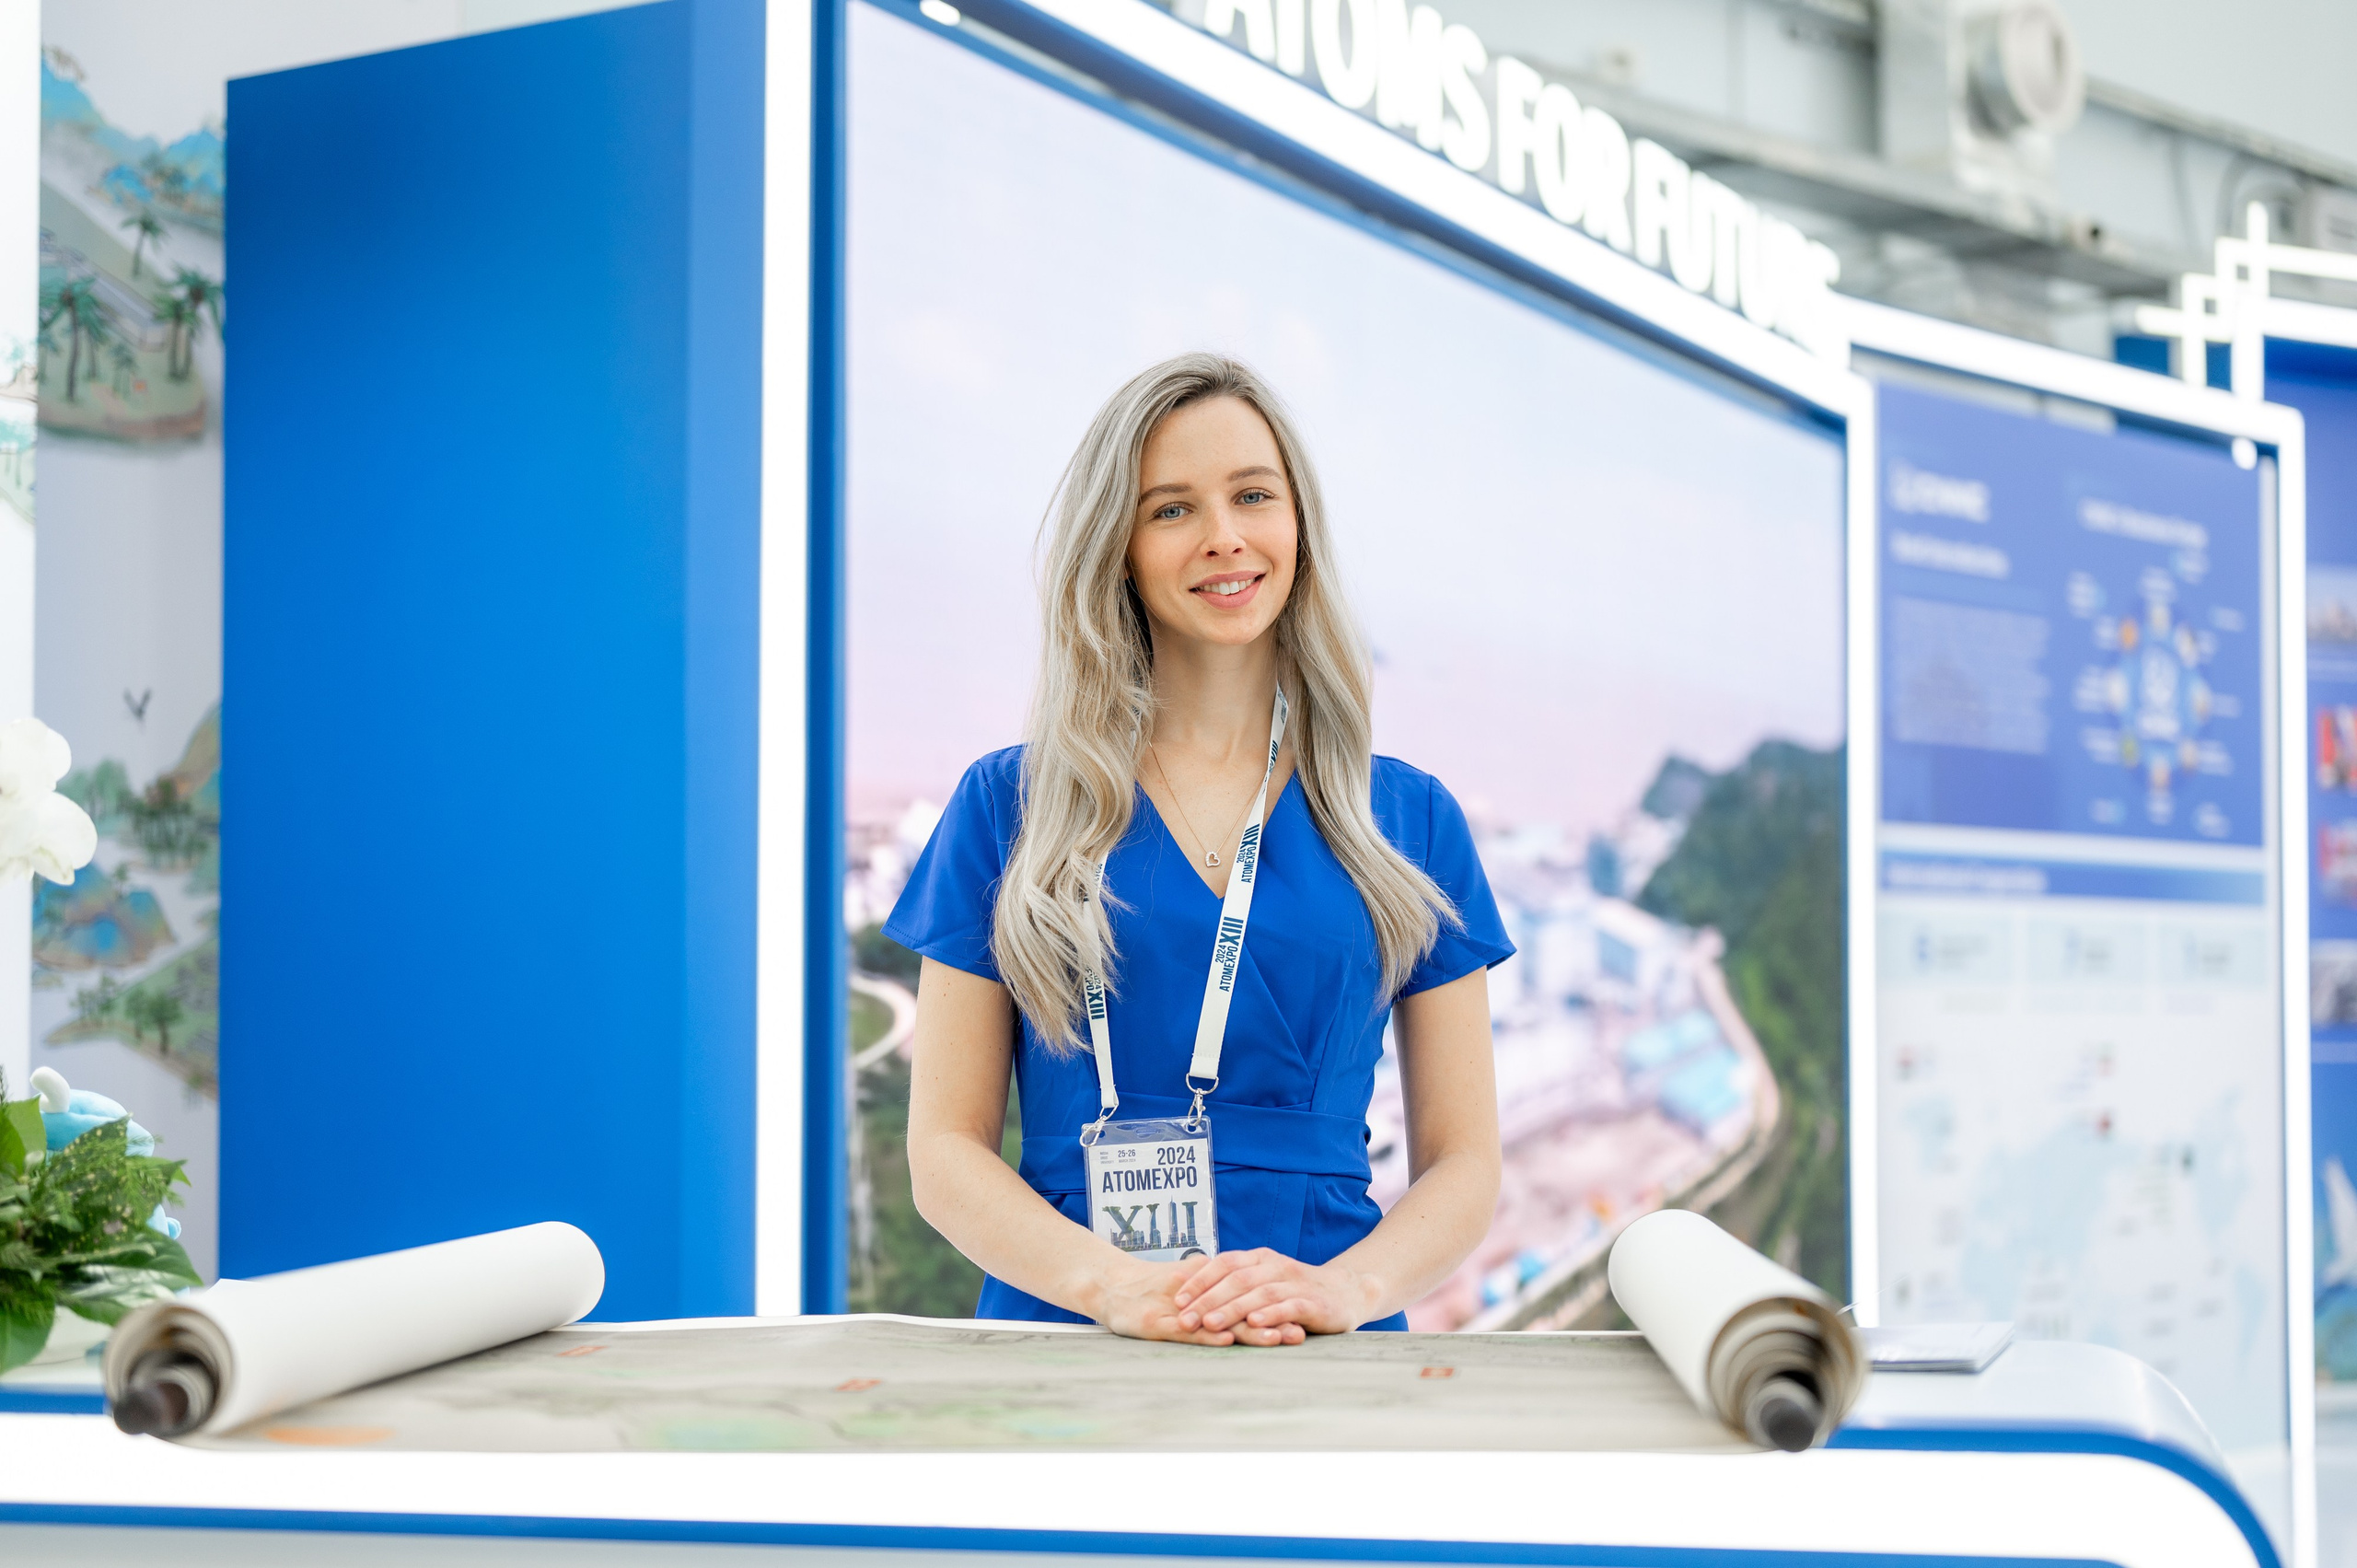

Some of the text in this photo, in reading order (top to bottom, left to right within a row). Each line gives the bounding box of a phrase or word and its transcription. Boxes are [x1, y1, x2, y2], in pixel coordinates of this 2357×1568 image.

[1497, 55, 1631, 250] FOR
[1240, 823, 1260, 850] XIII
[1237, 848, 1247, 864] 2024
[1241, 846, 1257, 883] ATOMEXPO
[1219, 916, 1244, 947] XIII
[1215, 945, 1226, 964] 2024
[1219, 946, 1238, 993] ATOMEXPO
[1087, 990, 1105, 1020] XIII
[1118, 1149, 1136, 1157] 25-26
[1156, 1145, 1196, 1166] 2024
[1102, 1166, 1198, 1193] ATOMEXPO
